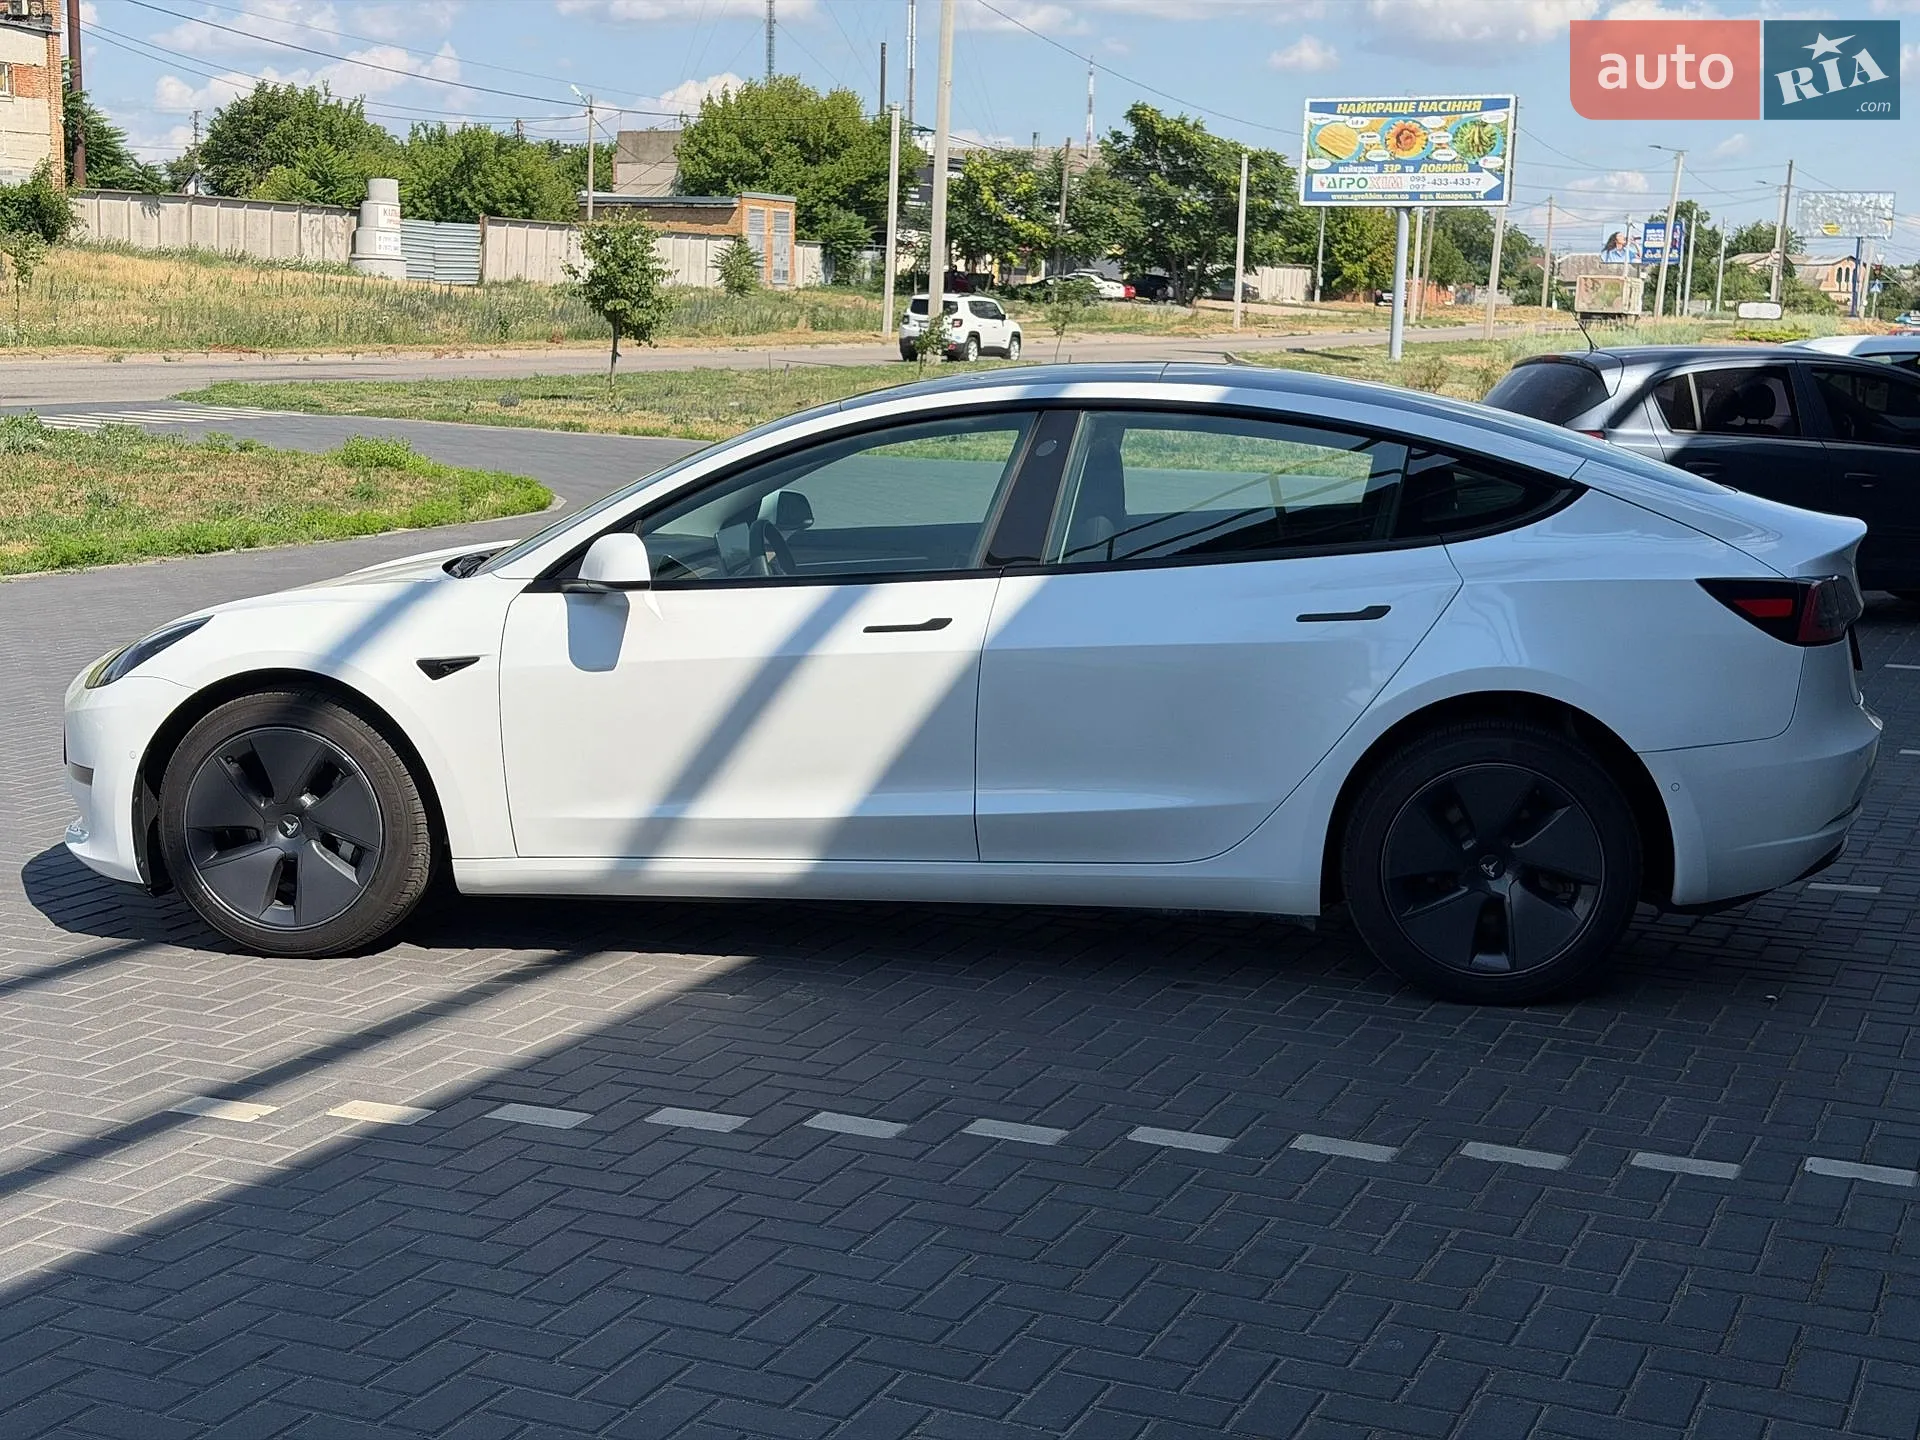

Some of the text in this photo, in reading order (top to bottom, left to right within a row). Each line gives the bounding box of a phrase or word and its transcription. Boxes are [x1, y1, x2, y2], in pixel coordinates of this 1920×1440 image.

[1336, 101, 1482, 114] НАЙКРАЩЕ НАСІННЯ
[1419, 163, 1469, 173] ДОБРИВА
